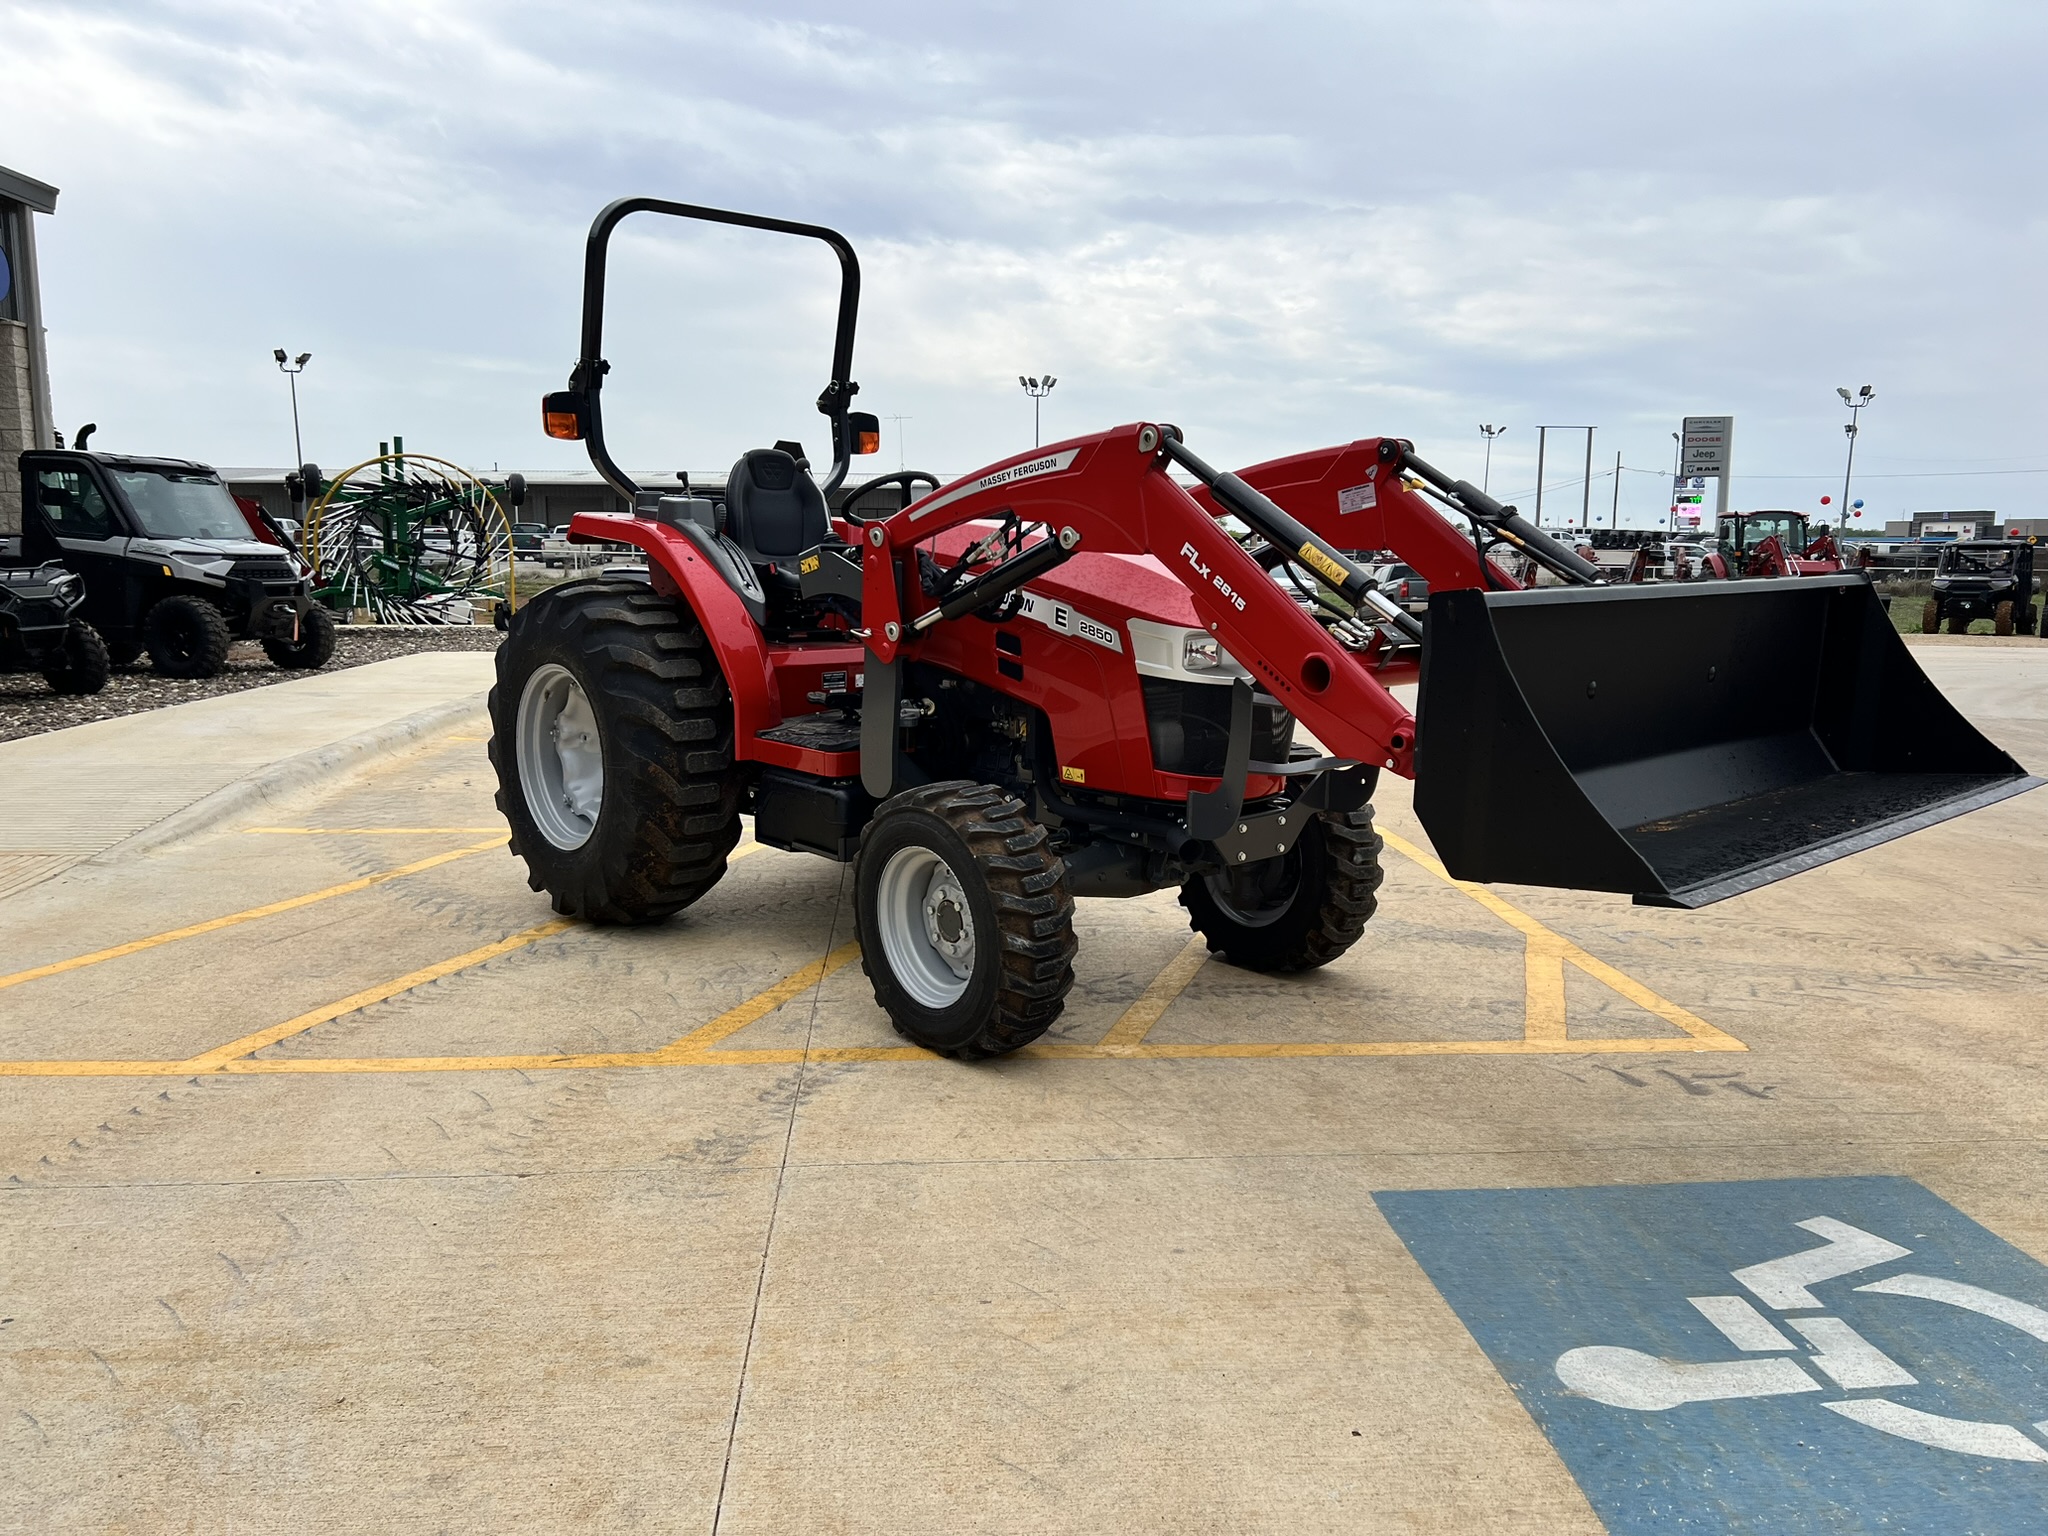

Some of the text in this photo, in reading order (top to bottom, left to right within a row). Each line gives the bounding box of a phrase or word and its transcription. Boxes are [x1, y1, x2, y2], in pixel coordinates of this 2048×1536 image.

[1692, 449, 1715, 459] Jeep
[980, 458, 1057, 488] MASSEY FERGUSON
[1055, 606, 1114, 645] E 2850
